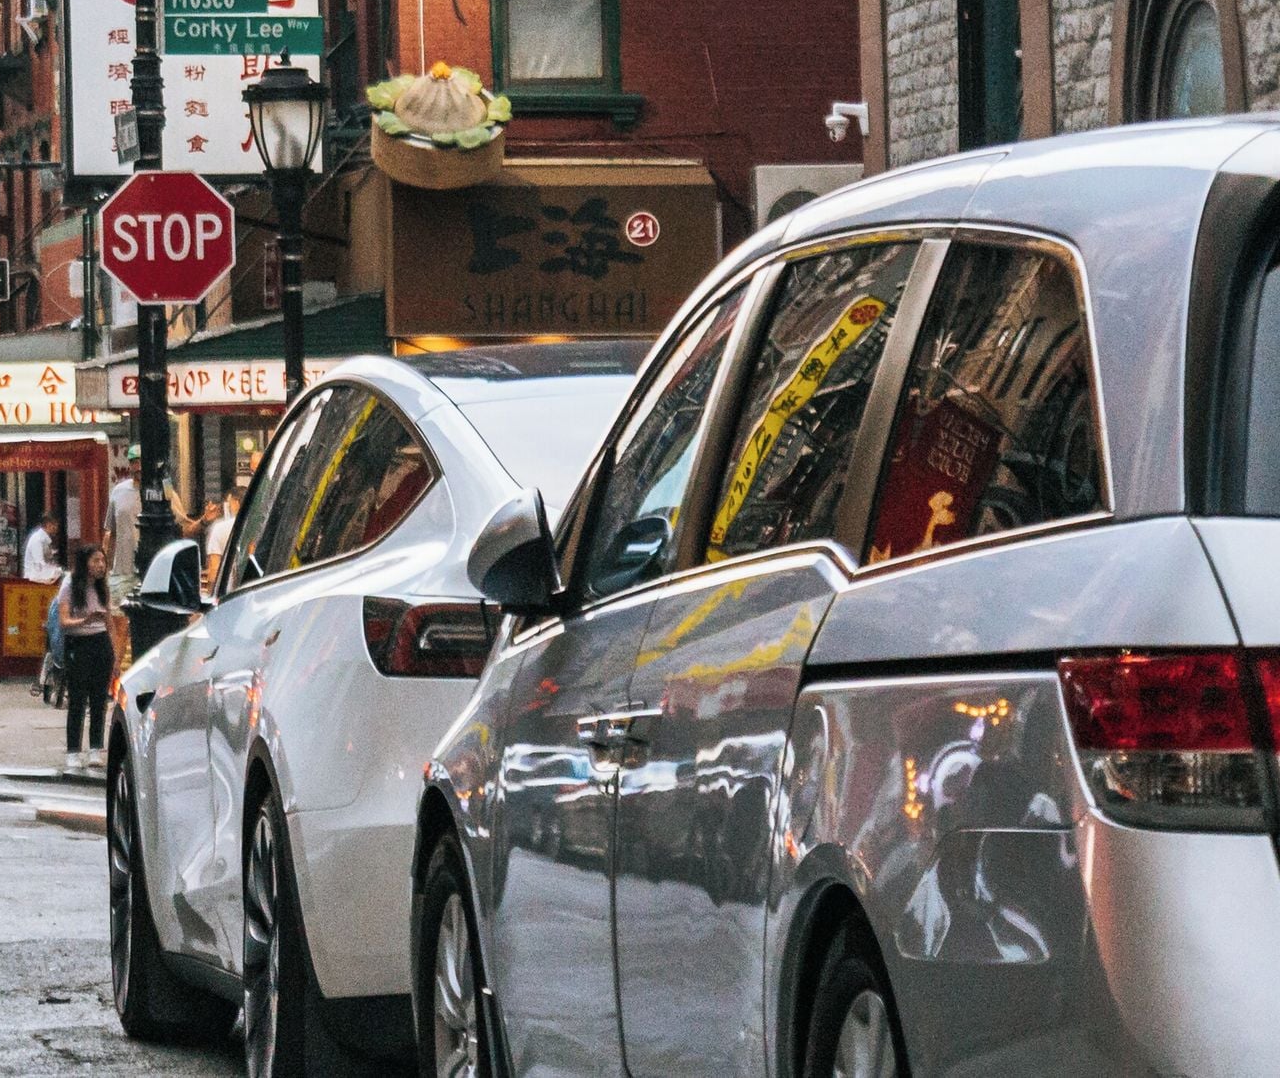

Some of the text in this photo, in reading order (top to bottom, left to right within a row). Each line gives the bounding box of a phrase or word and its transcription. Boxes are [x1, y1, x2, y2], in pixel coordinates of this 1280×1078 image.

[173, 18, 310, 42] Corky Lee Way
[111, 213, 223, 262] STOP
[631, 219, 654, 239] 21
[223, 370, 268, 396] KEE
